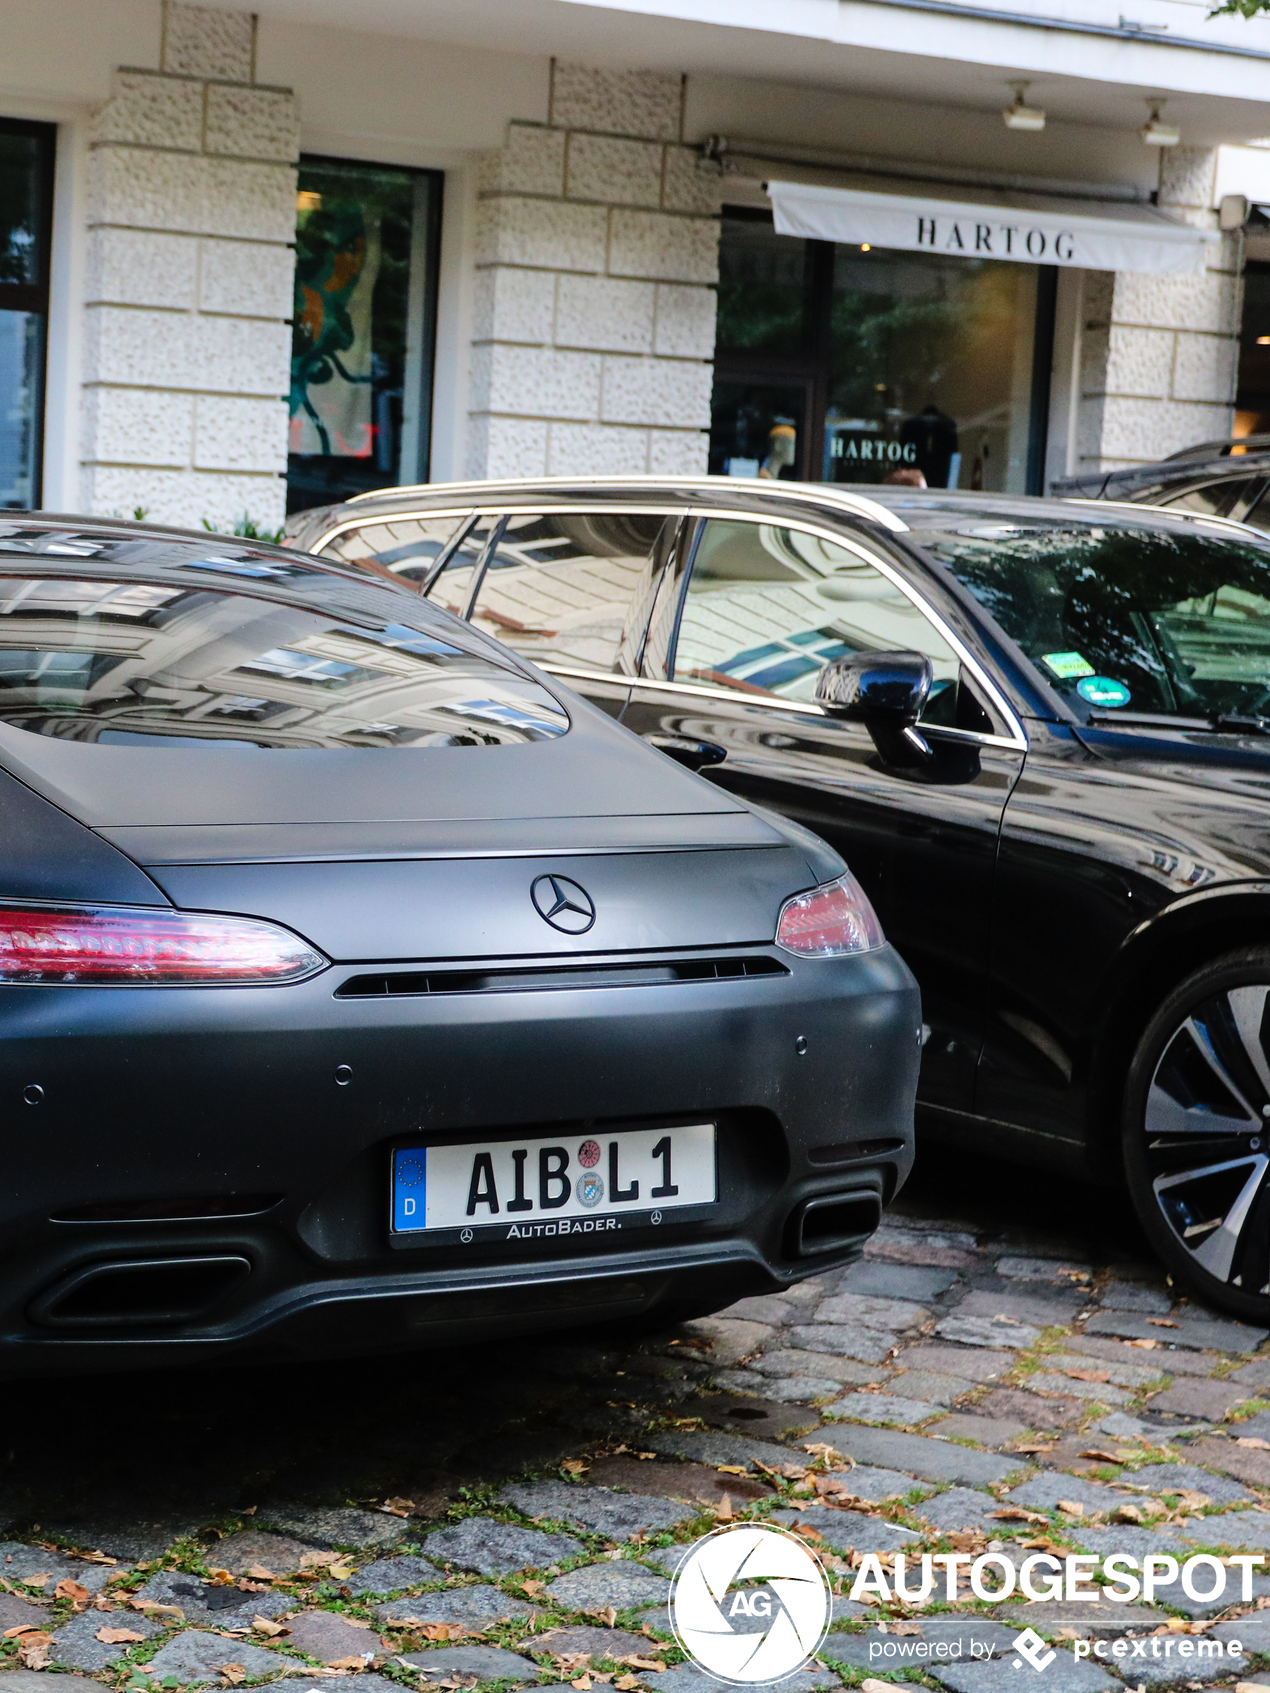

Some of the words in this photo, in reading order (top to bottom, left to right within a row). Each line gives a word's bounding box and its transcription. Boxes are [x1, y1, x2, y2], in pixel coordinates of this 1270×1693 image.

[917, 217, 1074, 261] HARTOG
[831, 436, 917, 463] HARTOG
[466, 1146, 572, 1216] AIB
[404, 1198, 416, 1216] D
